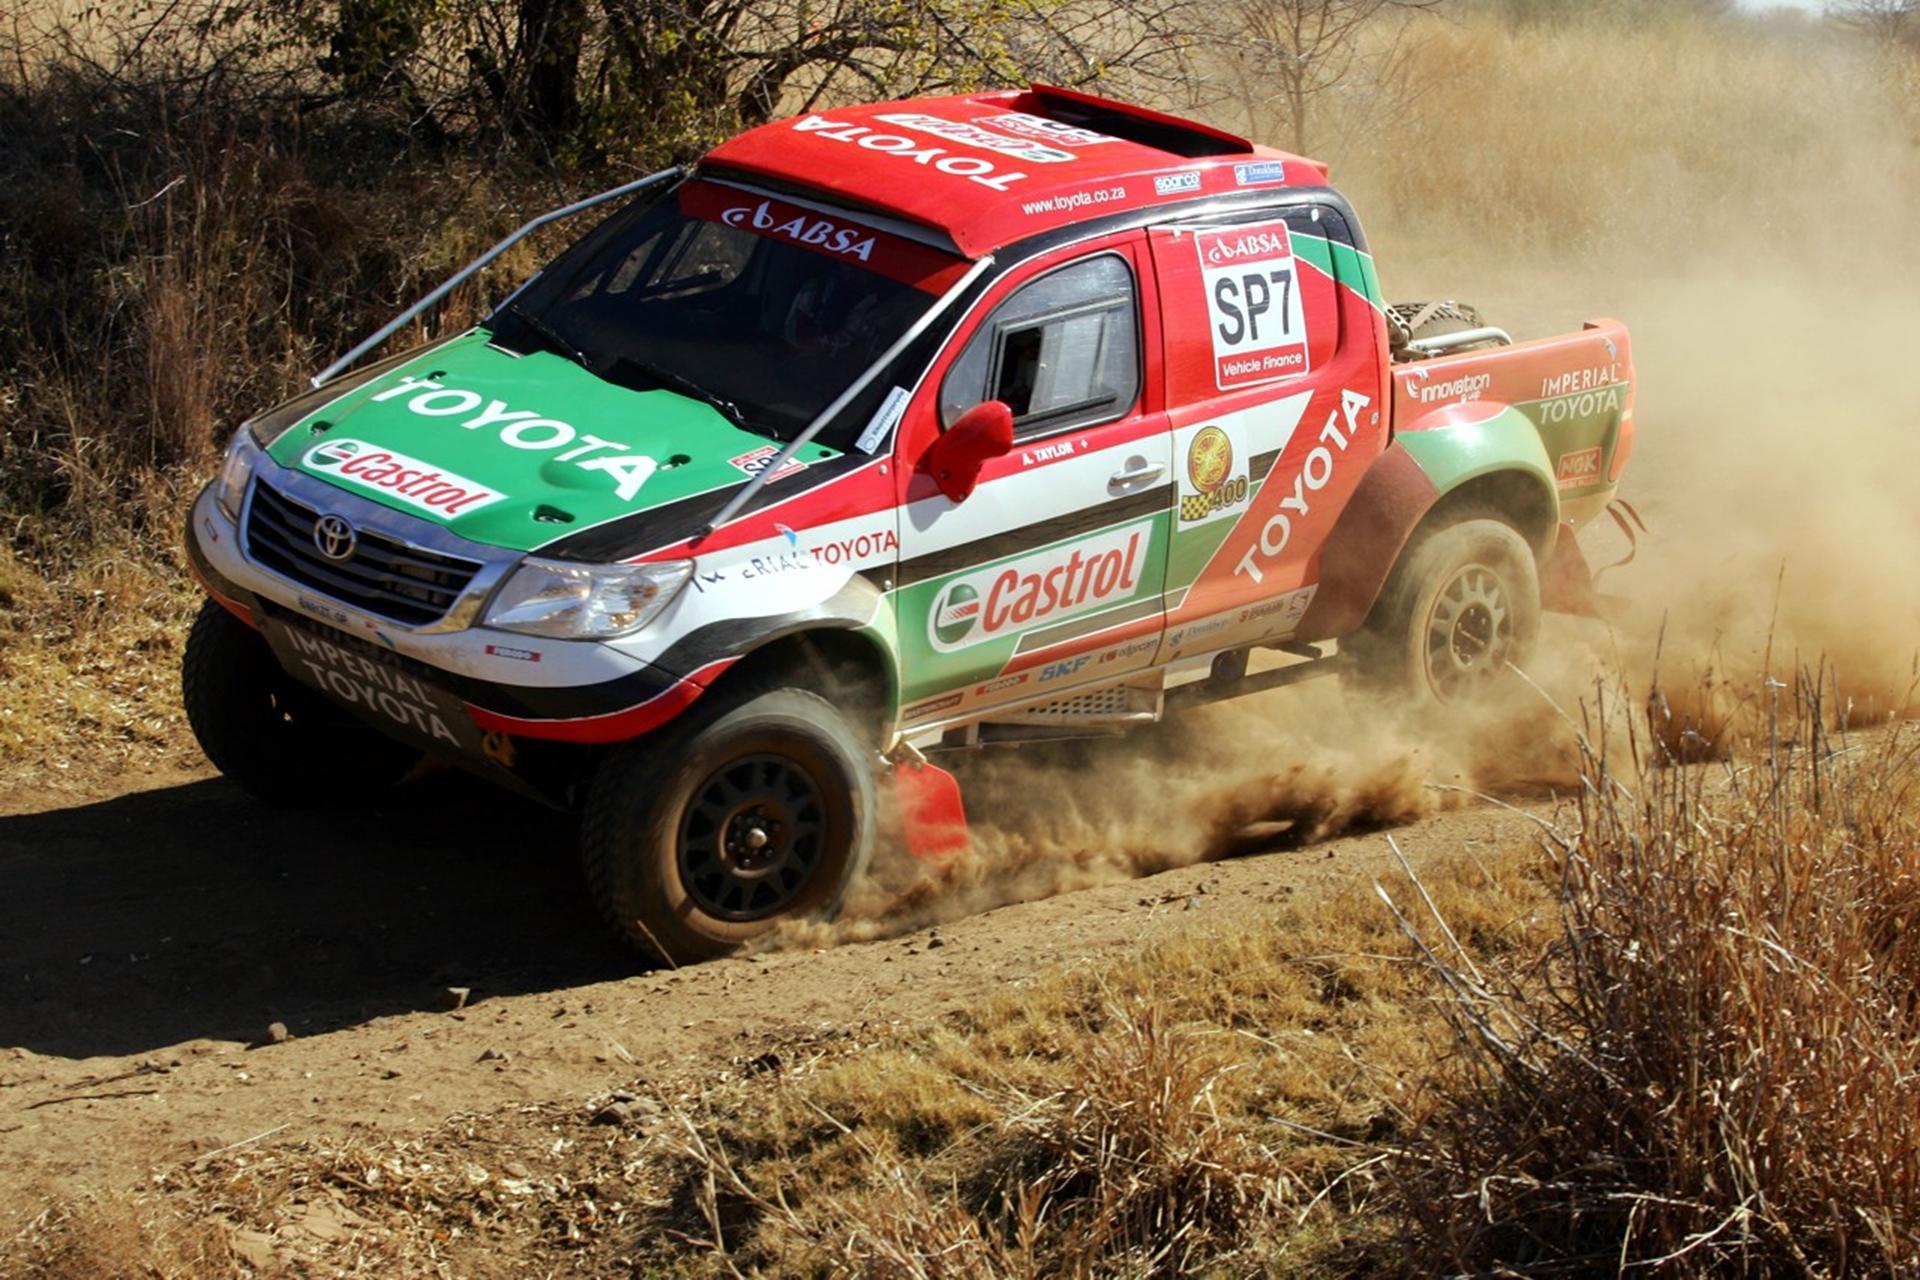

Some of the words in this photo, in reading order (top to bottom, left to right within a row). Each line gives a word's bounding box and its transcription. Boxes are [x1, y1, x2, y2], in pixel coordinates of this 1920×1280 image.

[792, 115, 1028, 192] TOYOTA
[1022, 186, 1126, 216] www.toyota.co.za
[1155, 172, 1201, 193] sparco
[772, 206, 876, 262] ABSA
[1236, 233, 1284, 256] ABSA
[1214, 269, 1292, 346] SP7
[1223, 359, 1262, 377] Vehicle
[1263, 352, 1303, 370] Finance
[1541, 363, 1620, 397] IMPERIAL
[1420, 372, 1491, 403] innovation
[1540, 388, 1619, 425] TOYOTA
[370, 375, 659, 502] TOYOTA
[1022, 452, 1034, 466] A.
[1034, 441, 1075, 463] TAYLOR
[1558, 452, 1599, 475] NGK
[339, 452, 490, 515] Castrol
[1208, 474, 1249, 512] 400
[1233, 388, 1372, 584] TOYOTA
[810, 529, 900, 566] TOYOTA
[982, 531, 1140, 633] Castrol
[283, 624, 439, 710] IMPERIAL
[1038, 655, 1092, 683] SKF
[301, 658, 463, 749] TOYOTA
